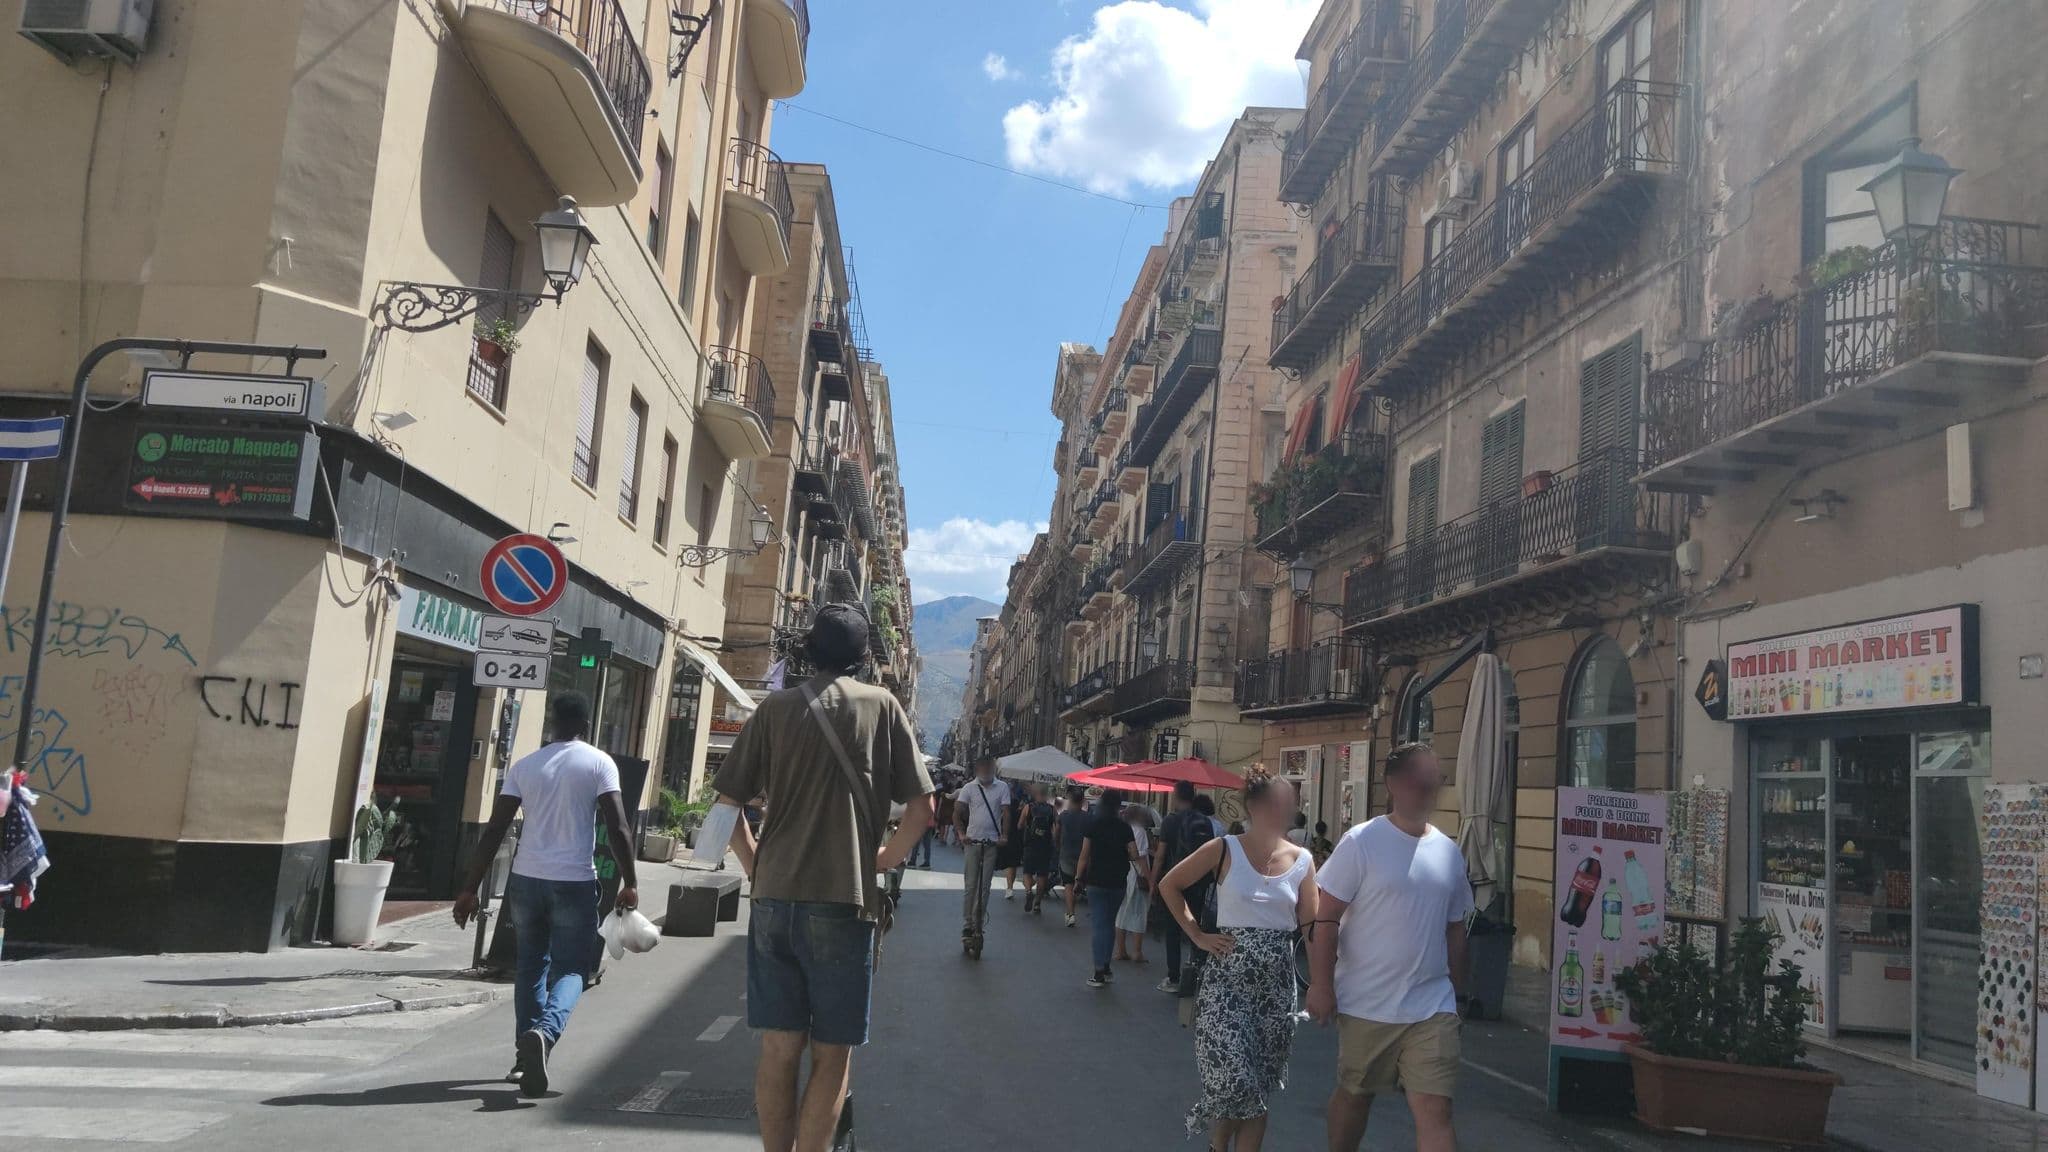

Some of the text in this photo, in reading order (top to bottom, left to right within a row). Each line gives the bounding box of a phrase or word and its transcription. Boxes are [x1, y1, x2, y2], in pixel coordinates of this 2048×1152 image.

[223, 393, 297, 408] via napoli
[171, 434, 299, 458] Mercato Maqueda
[1731, 626, 1952, 679] MINI MARKET
[484, 661, 538, 681] 0-24
[1587, 794, 1638, 809] PALERMO
[1576, 806, 1650, 824] FOOD & DRINK
[1562, 817, 1663, 845] MINI MARKET
[1785, 887, 1800, 906] Food
[1808, 890, 1825, 909] Drink
